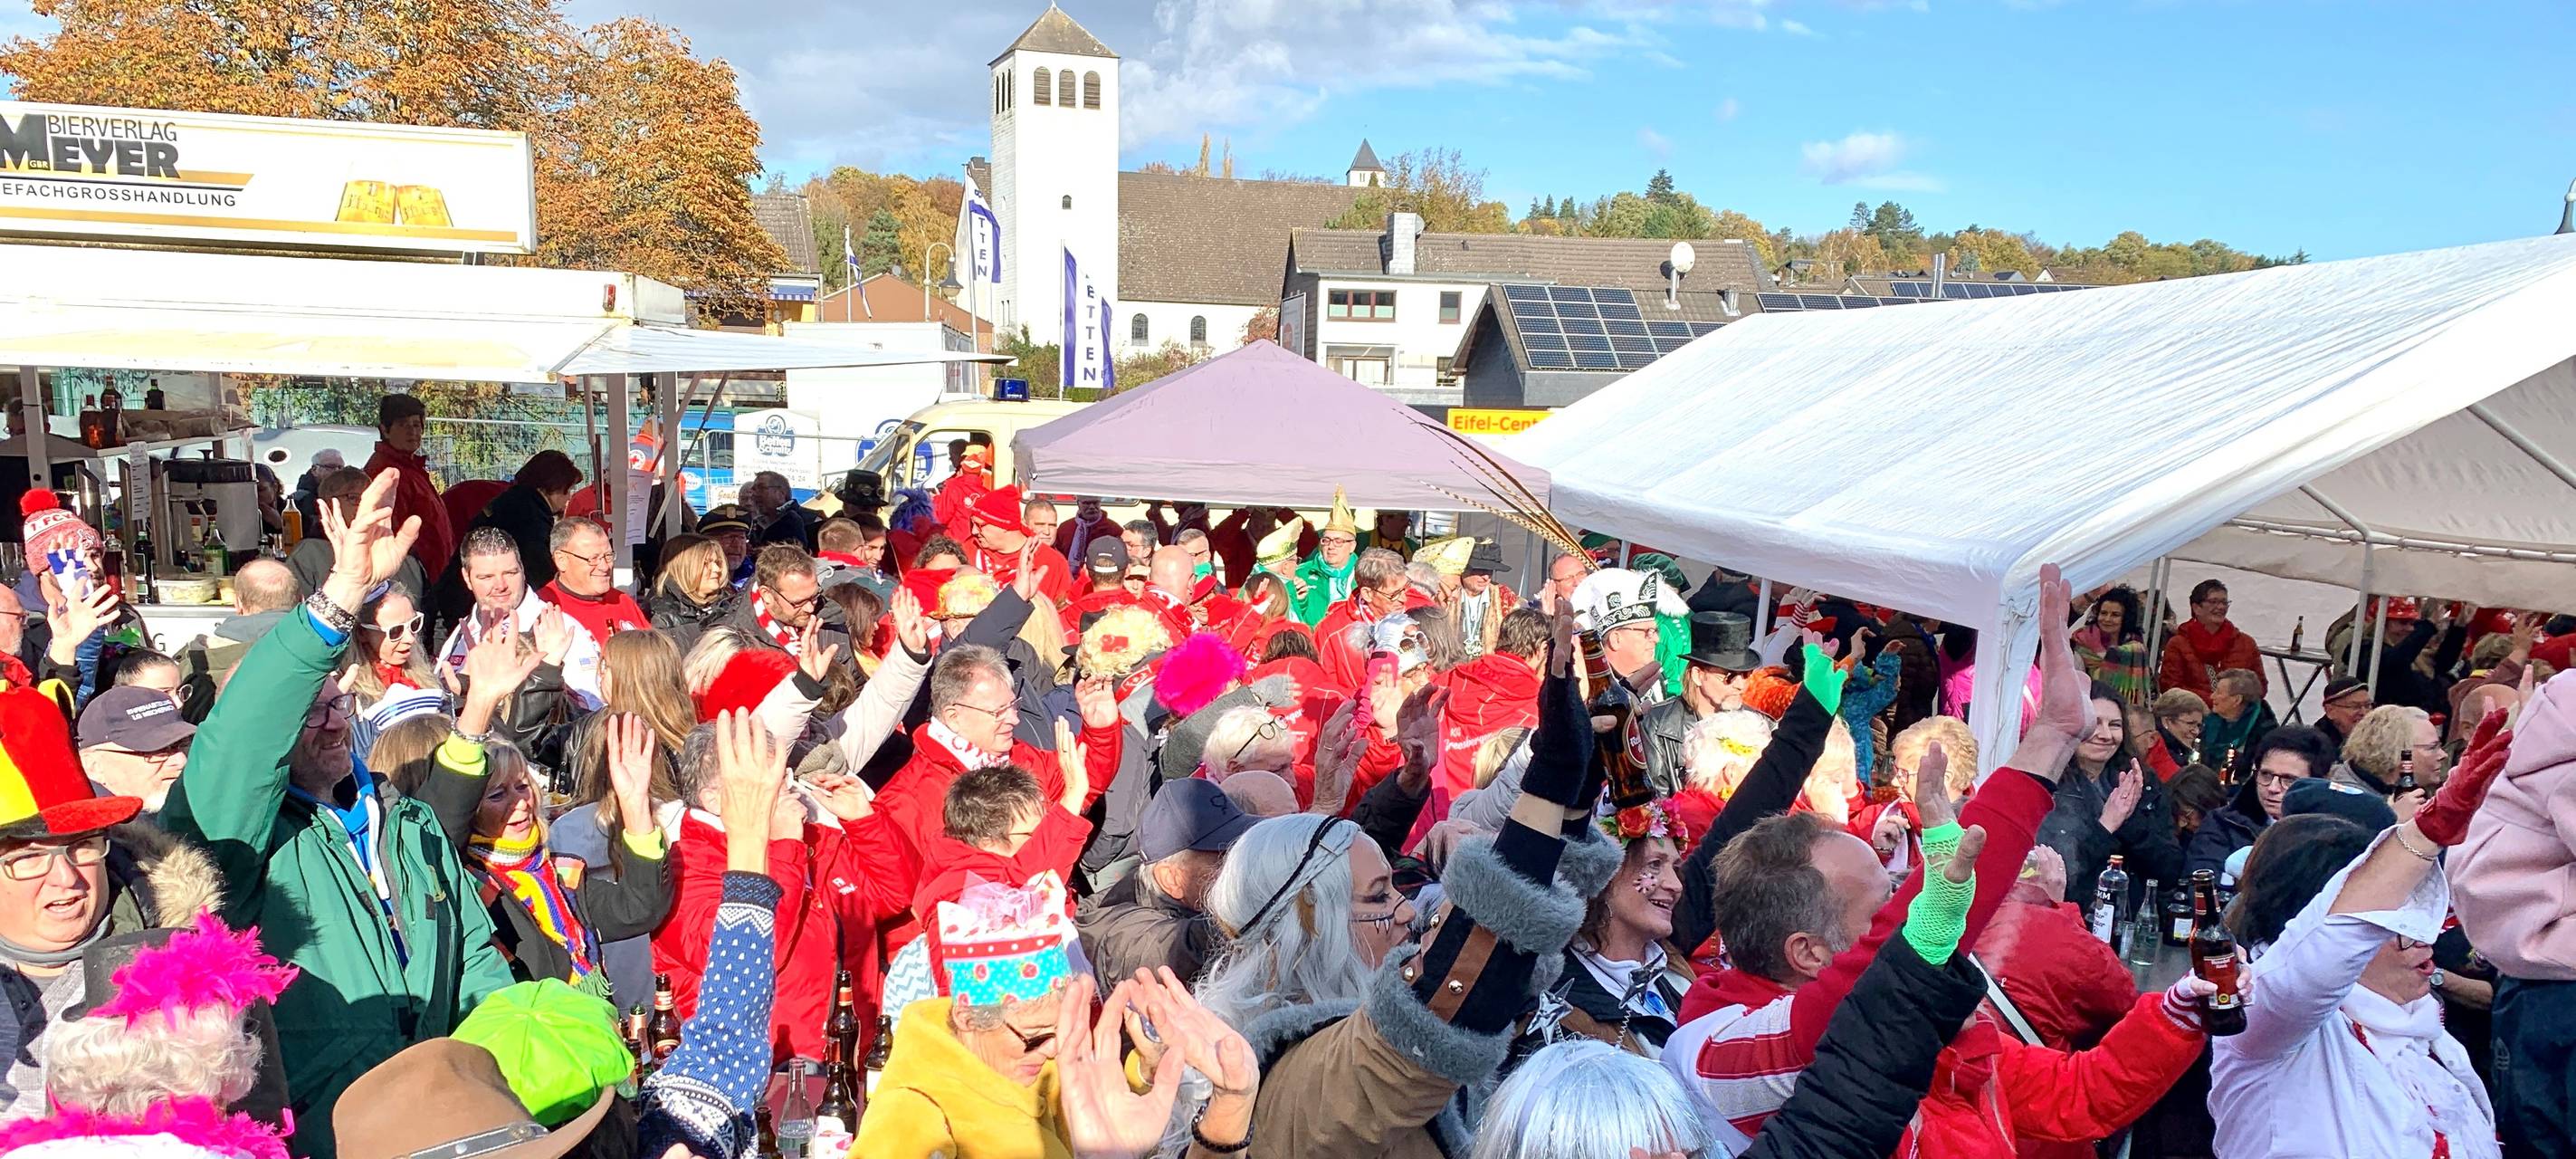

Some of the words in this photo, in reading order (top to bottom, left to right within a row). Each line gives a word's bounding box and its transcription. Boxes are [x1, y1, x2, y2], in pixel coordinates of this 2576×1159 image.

[48, 114, 177, 141] BIERVERLAG
[0, 113, 181, 178] MEYER
[29, 159, 49, 169] GBR
